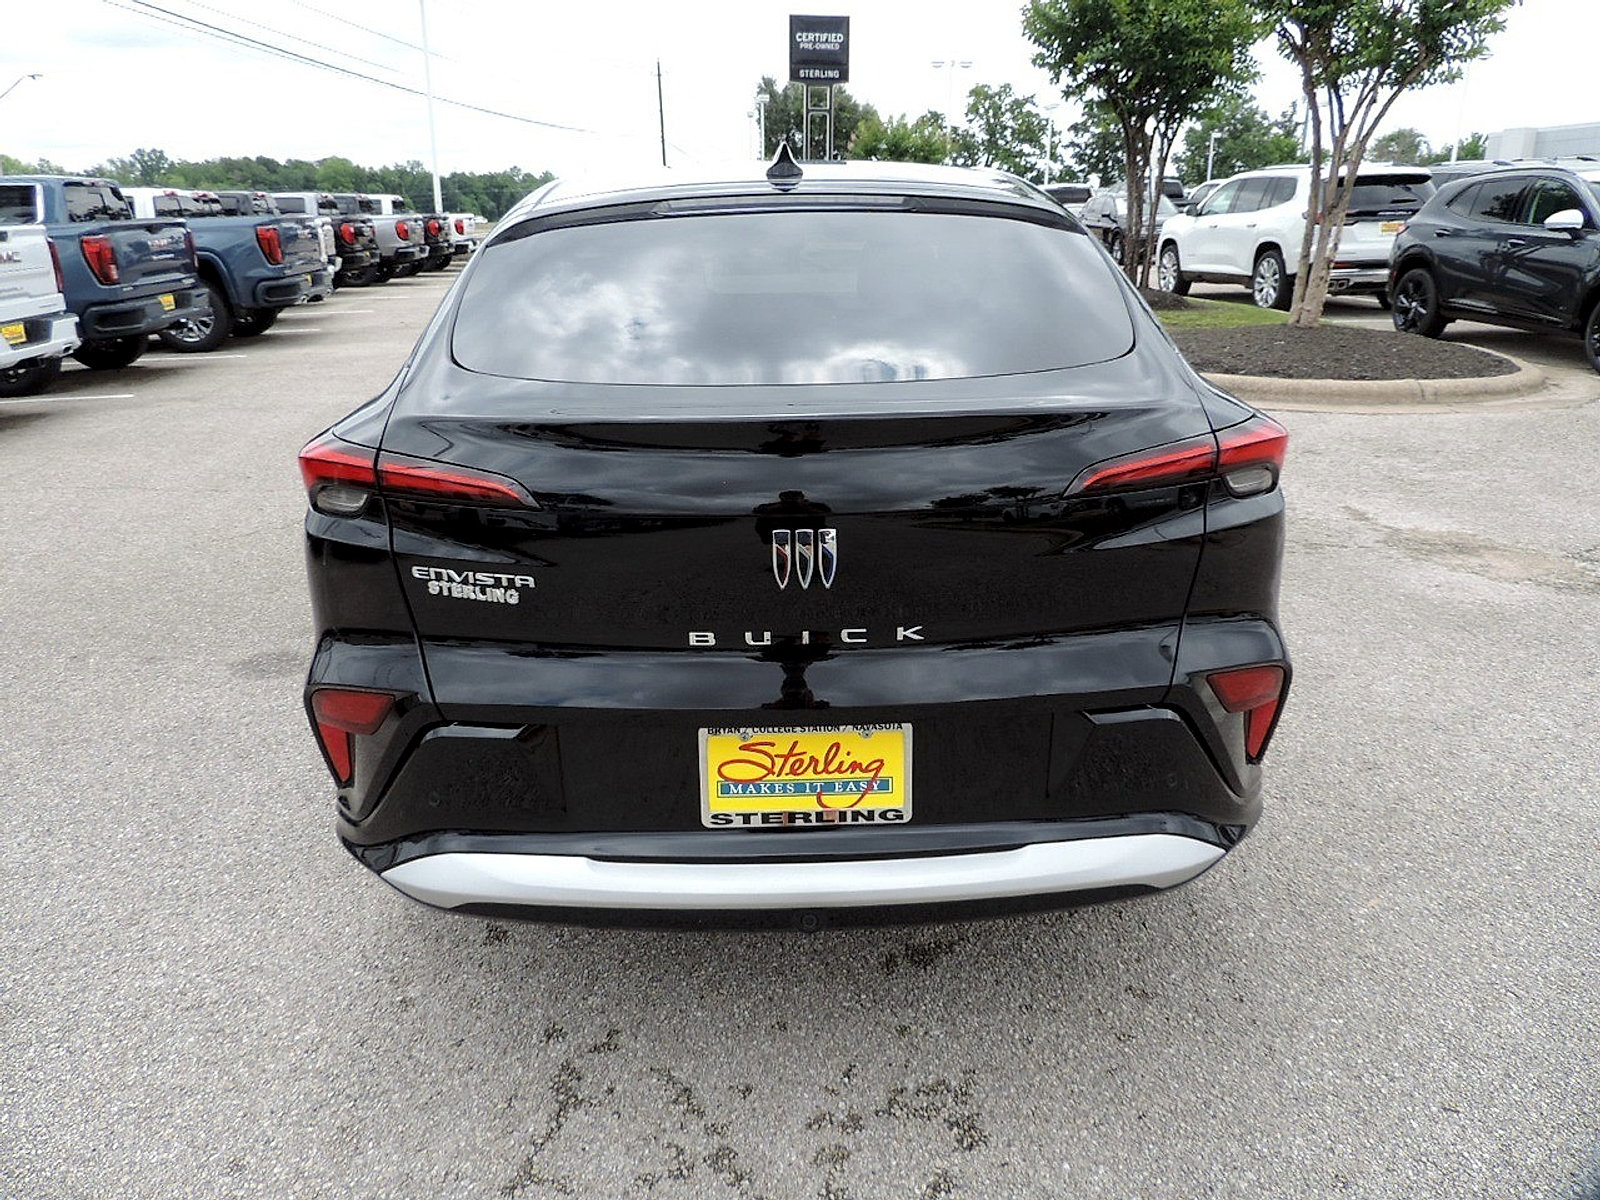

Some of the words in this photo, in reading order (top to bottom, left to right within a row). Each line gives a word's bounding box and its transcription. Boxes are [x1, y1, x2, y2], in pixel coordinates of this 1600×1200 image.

[796, 32, 844, 43] CERTIFIED
[800, 42, 840, 50] PRE-OWNED
[799, 69, 840, 78] STERLING
[411, 566, 536, 588] ENVISTA
[427, 580, 520, 604] STERLING
[688, 626, 925, 646] BUICK
[707, 726, 741, 735] BRYAN
[752, 726, 799, 734] COLLEGE
[799, 725, 840, 733] STATION
[717, 740, 885, 809] Sterling
[729, 782, 795, 794] MAKES
[804, 782, 825, 793] IT
[834, 780, 881, 792] EASY
[710, 808, 904, 825] STERLING
